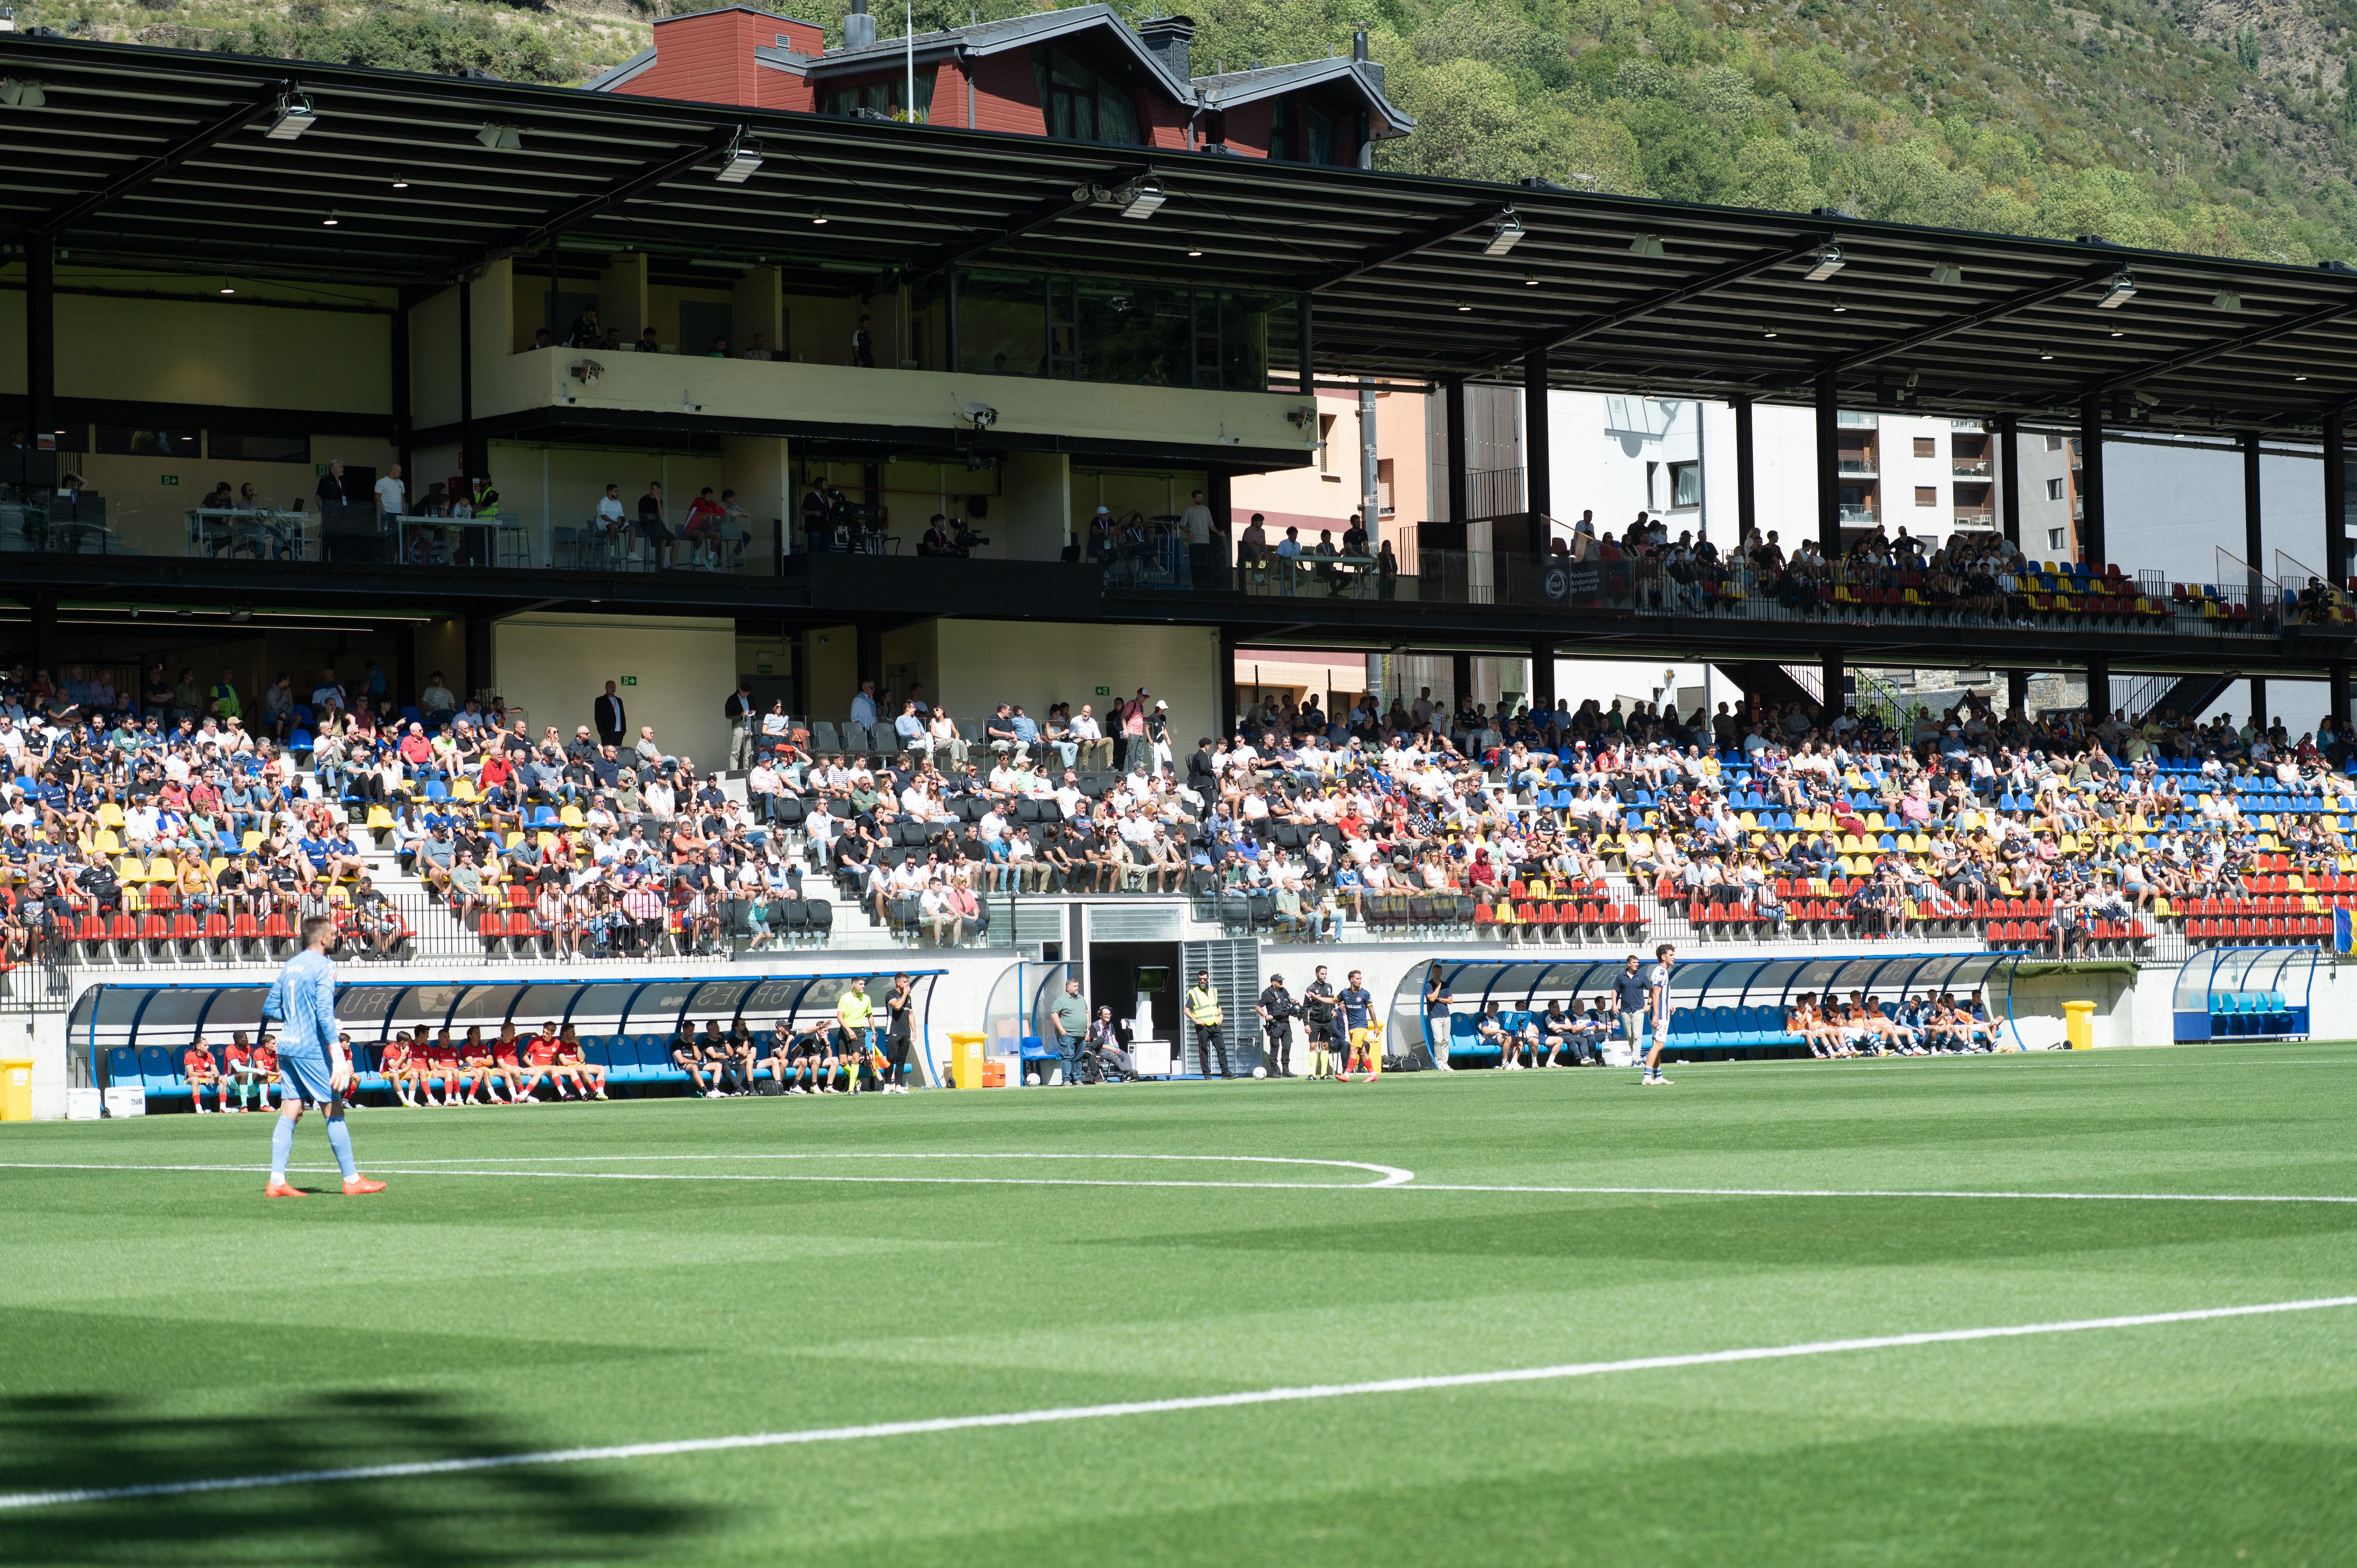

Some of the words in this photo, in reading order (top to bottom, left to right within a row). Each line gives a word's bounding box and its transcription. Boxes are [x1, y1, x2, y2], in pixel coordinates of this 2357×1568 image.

[1570, 569, 1597, 578] Federació
[1570, 577, 1599, 586] Andorrana
[1579, 584, 1597, 592] Futbol
[288, 979, 295, 1017] 1
[1657, 1024, 1666, 1033] 23
